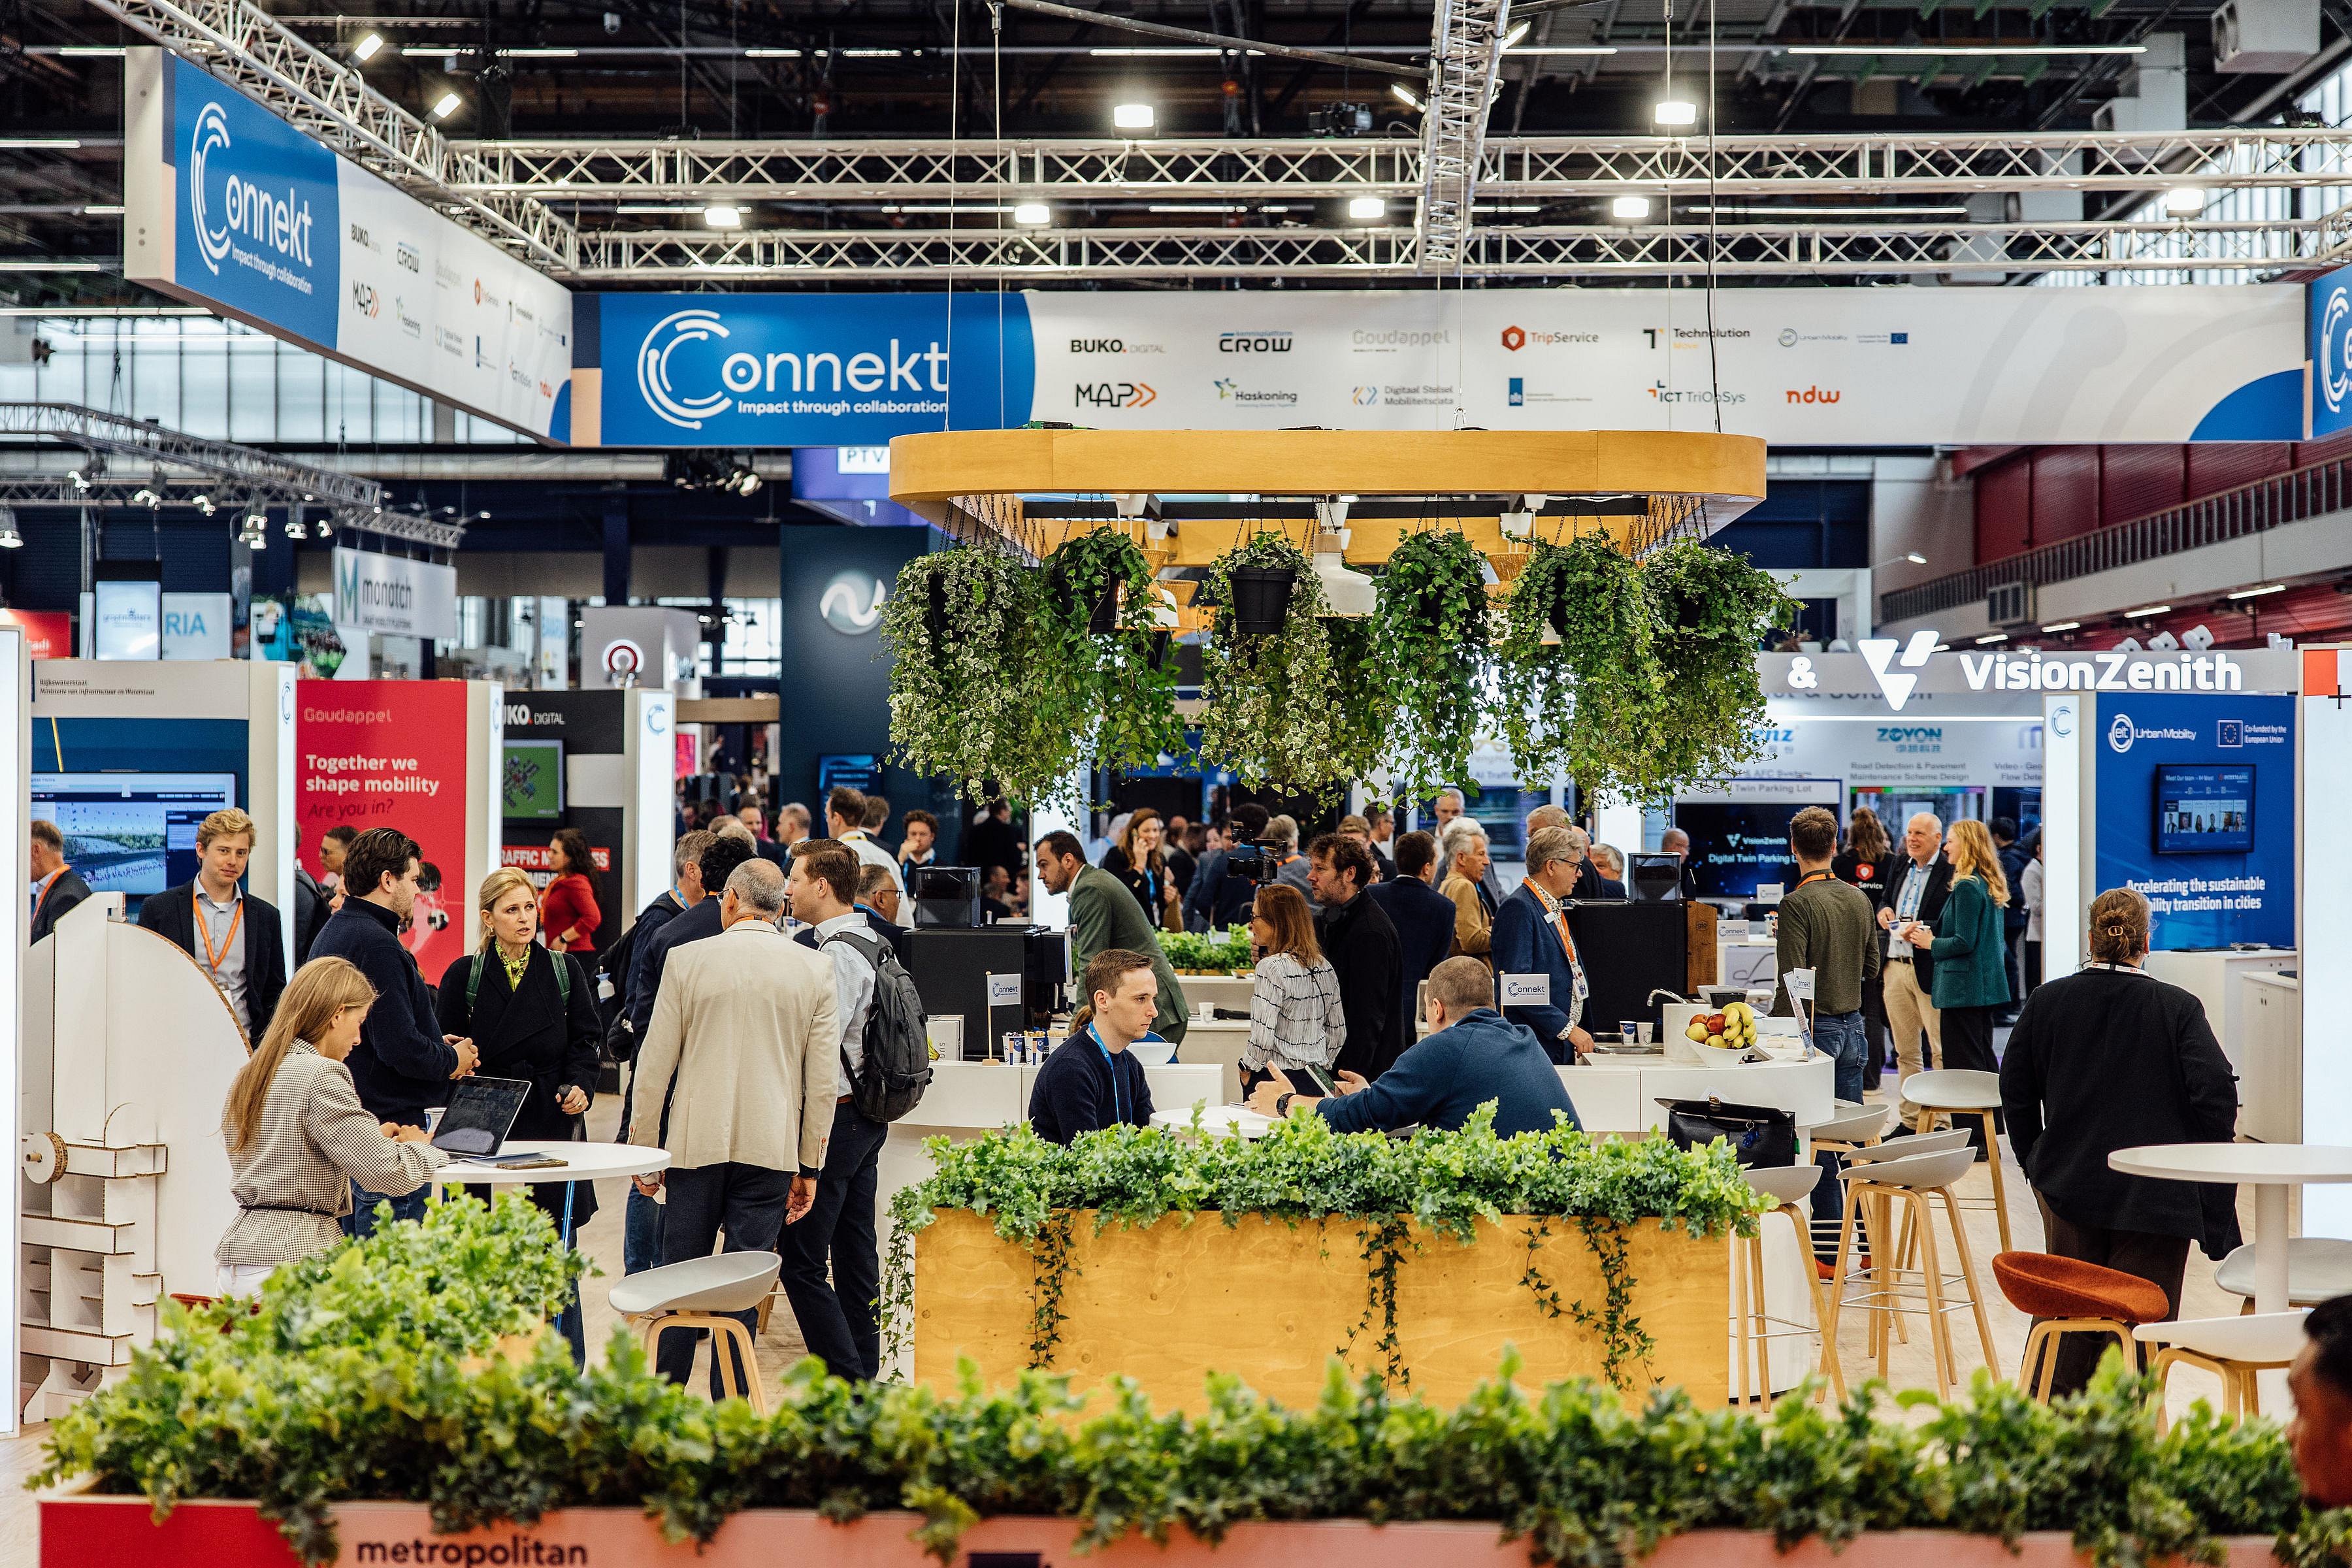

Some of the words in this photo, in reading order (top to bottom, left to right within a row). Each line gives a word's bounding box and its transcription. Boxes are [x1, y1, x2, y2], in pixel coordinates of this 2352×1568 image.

[190, 101, 313, 276] Connekt
[231, 242, 253, 267] Impact
[253, 253, 277, 280] through
[276, 264, 313, 295] collaboration
[1220, 338, 1292, 352] CROW
[1352, 329, 1450, 346] Goudappel
[1530, 331, 1599, 346] TripService
[637, 309, 948, 430] Connekt
[1235, 391, 1298, 402] Haskoning
[1384, 385, 1420, 395] Digitaal
[1659, 392, 1683, 402] ICT
[1786, 385, 1840, 404] ndw
[738, 400, 789, 416] Impact
[792, 400, 851, 416] through
[853, 399, 948, 414] collaboration
[847, 449, 885, 463] PTV
[165, 612, 206, 636] RIA
[1786, 655, 1819, 689] &
[1959, 653, 2242, 691] VisionZenith
[304, 707, 392, 725] Goudappel
[534, 712, 566, 725] DIGITAL
[1877, 727, 1942, 742] ZOYON
[2134, 728, 2164, 740] Urban
[2164, 727, 2197, 741] Mobility
[2244, 724, 2266, 733] Co-funded
[2267, 724, 2276, 734] by
[2276, 725, 2287, 734] the
[2244, 735, 2268, 745] European
[2268, 734, 2285, 744] Union
[305, 754, 387, 776] Together
[391, 758, 418, 771] we
[1904, 772, 1938, 781] Scheme
[1940, 773, 1970, 782] Design
[305, 775, 359, 796] shape
[364, 775, 440, 797] mobility
[1758, 785, 1794, 794] Parking
[308, 804, 335, 818] Are
[336, 803, 367, 822] you
[370, 798, 393, 815] in?
[502, 850, 538, 866] RAFFIC
[1708, 853, 1735, 864] Digital
[1737, 853, 1756, 862] Twin
[1758, 853, 1790, 864] Parking
[2127, 879, 2189, 896] Accelerating
[2189, 877, 2208, 892] the
[2208, 875, 2266, 892] sustainable
[2173, 896, 2223, 912] transition
[2223, 895, 2233, 909] in
[2234, 894, 2262, 909] cities
[1719, 926, 1746, 937] Connekt
[992, 982, 1018, 998] Connekt
[1507, 981, 1545, 997] Connekt
[357, 1533, 588, 1568] metropolitan
